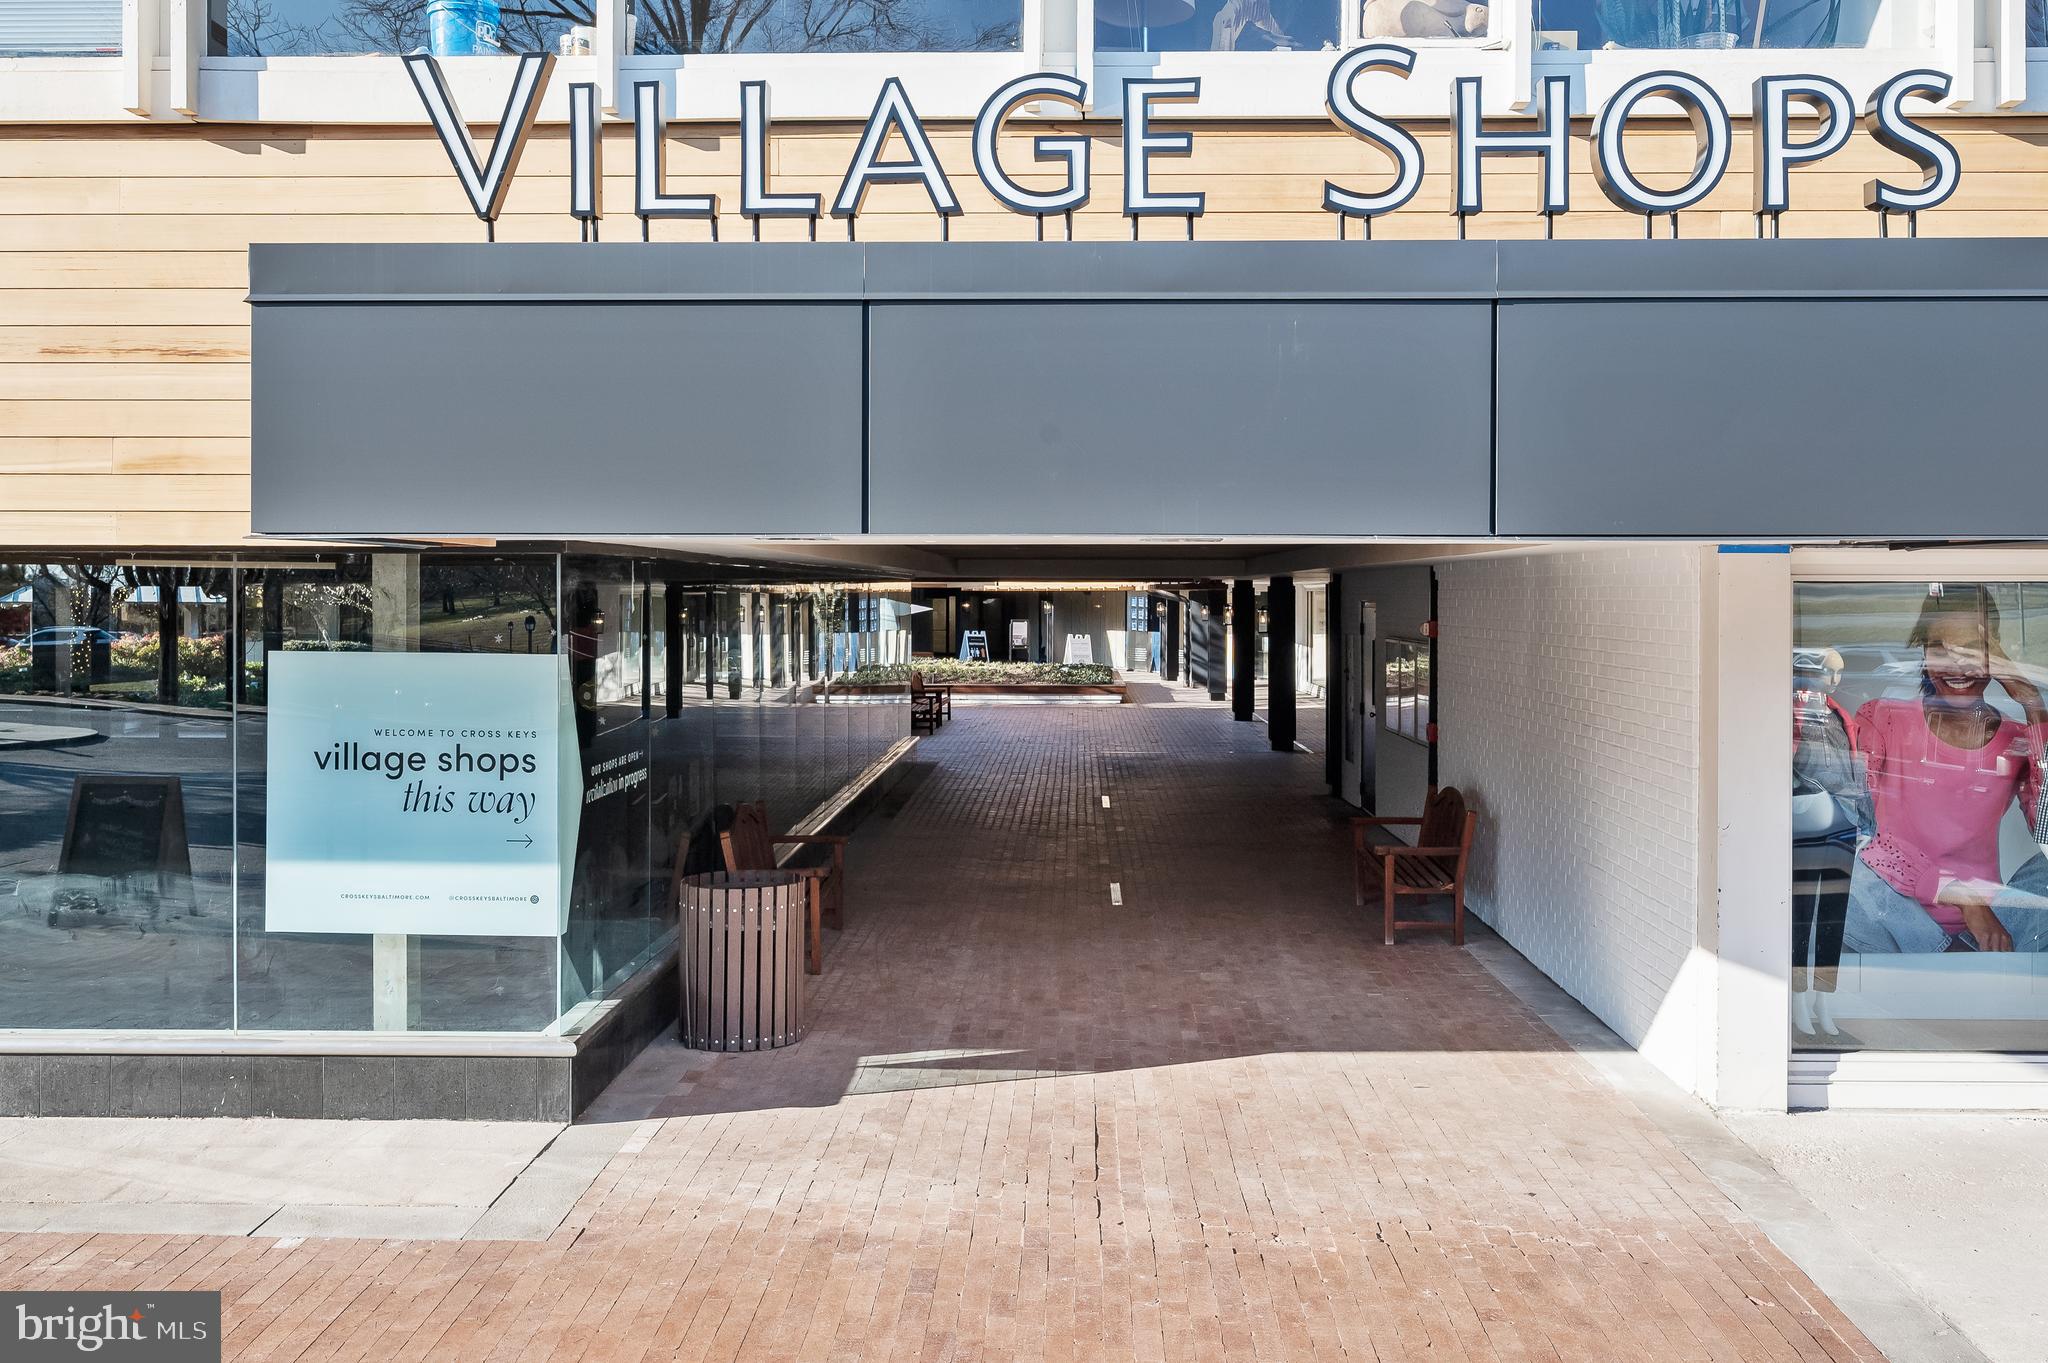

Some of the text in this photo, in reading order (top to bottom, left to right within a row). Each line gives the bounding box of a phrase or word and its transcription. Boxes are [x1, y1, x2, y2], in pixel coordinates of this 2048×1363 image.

[402, 44, 1962, 220] VILLAGE SHOPS
[374, 728, 537, 739] WELCOME TO CROSS KEYS
[314, 742, 537, 781] village shops
[591, 751, 639, 776] OUR SHOPS ARE OPEN
[619, 773, 624, 790] in
[625, 768, 647, 792] progress
[403, 779, 536, 825] this way
[340, 893, 431, 901] CROSSKEYSBALTIMORE.COM
